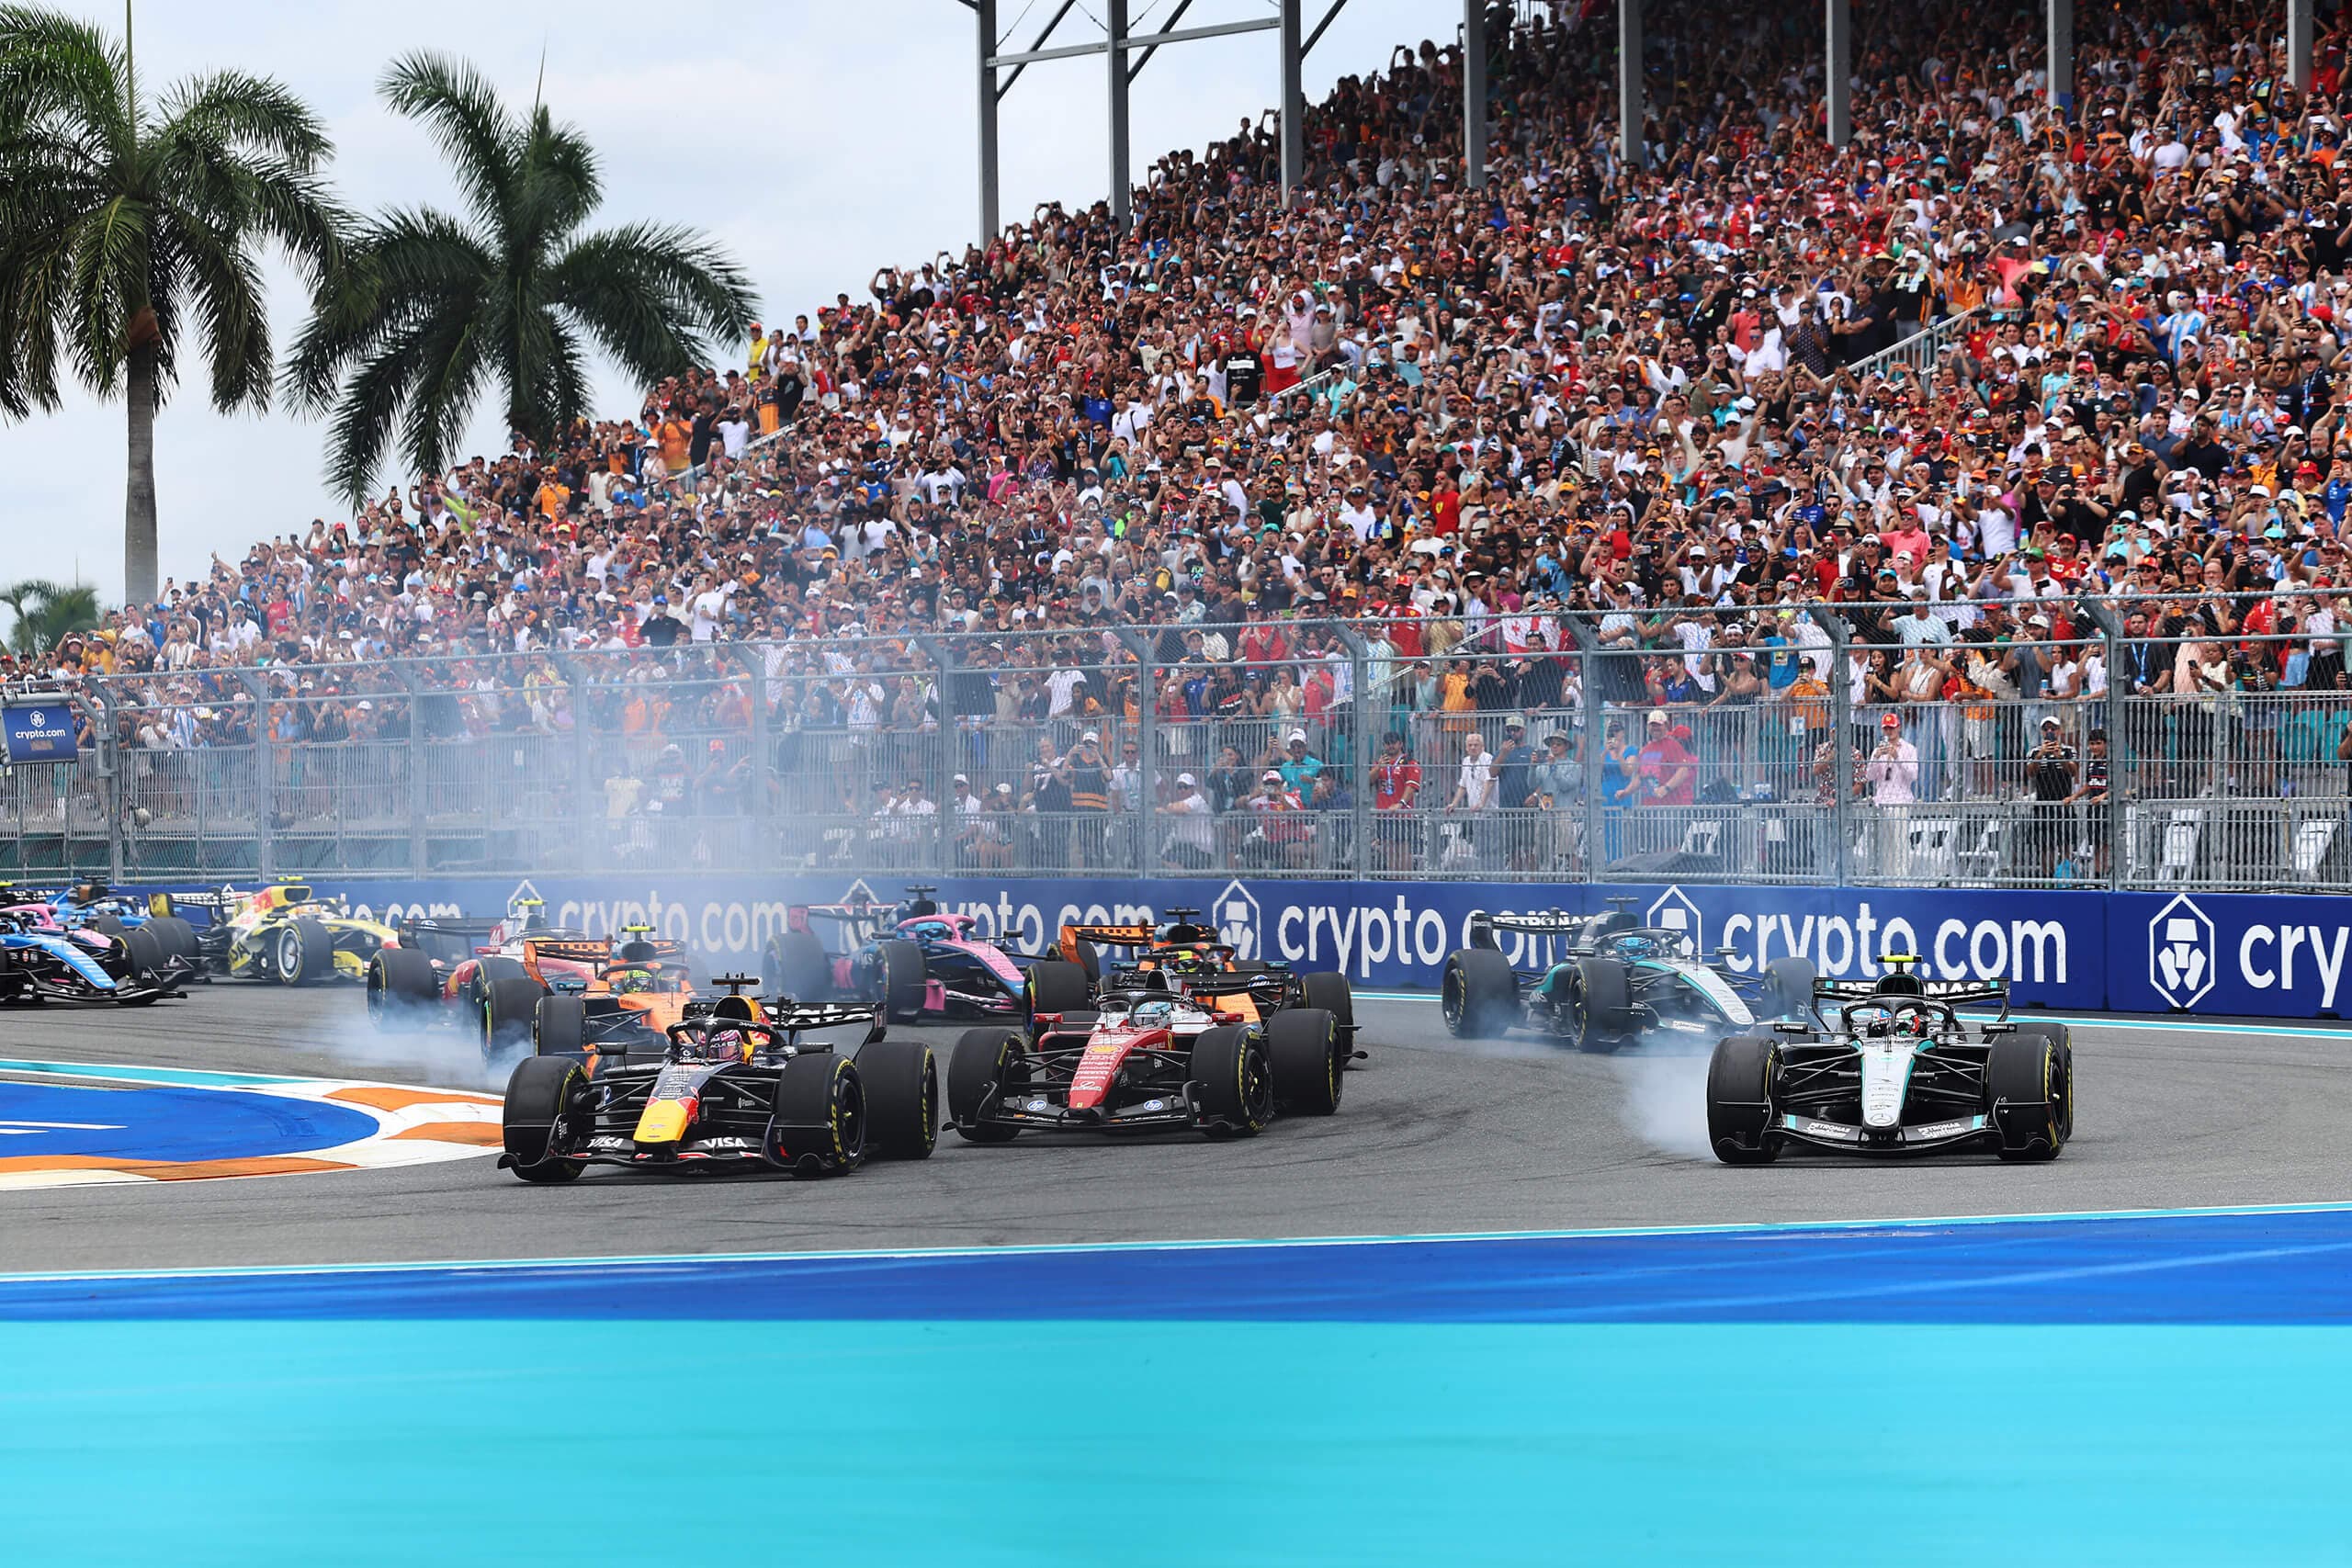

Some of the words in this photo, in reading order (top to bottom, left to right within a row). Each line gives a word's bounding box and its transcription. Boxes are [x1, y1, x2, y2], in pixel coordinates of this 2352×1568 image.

[15, 728, 66, 740] crypto.com
[1277, 895, 1573, 978] cryptocom
[1723, 902, 2067, 984] crypto.com
[1838, 981, 1984, 998] PENAS
[586, 1137, 625, 1148] VISA
[700, 1136, 749, 1148] VISA
